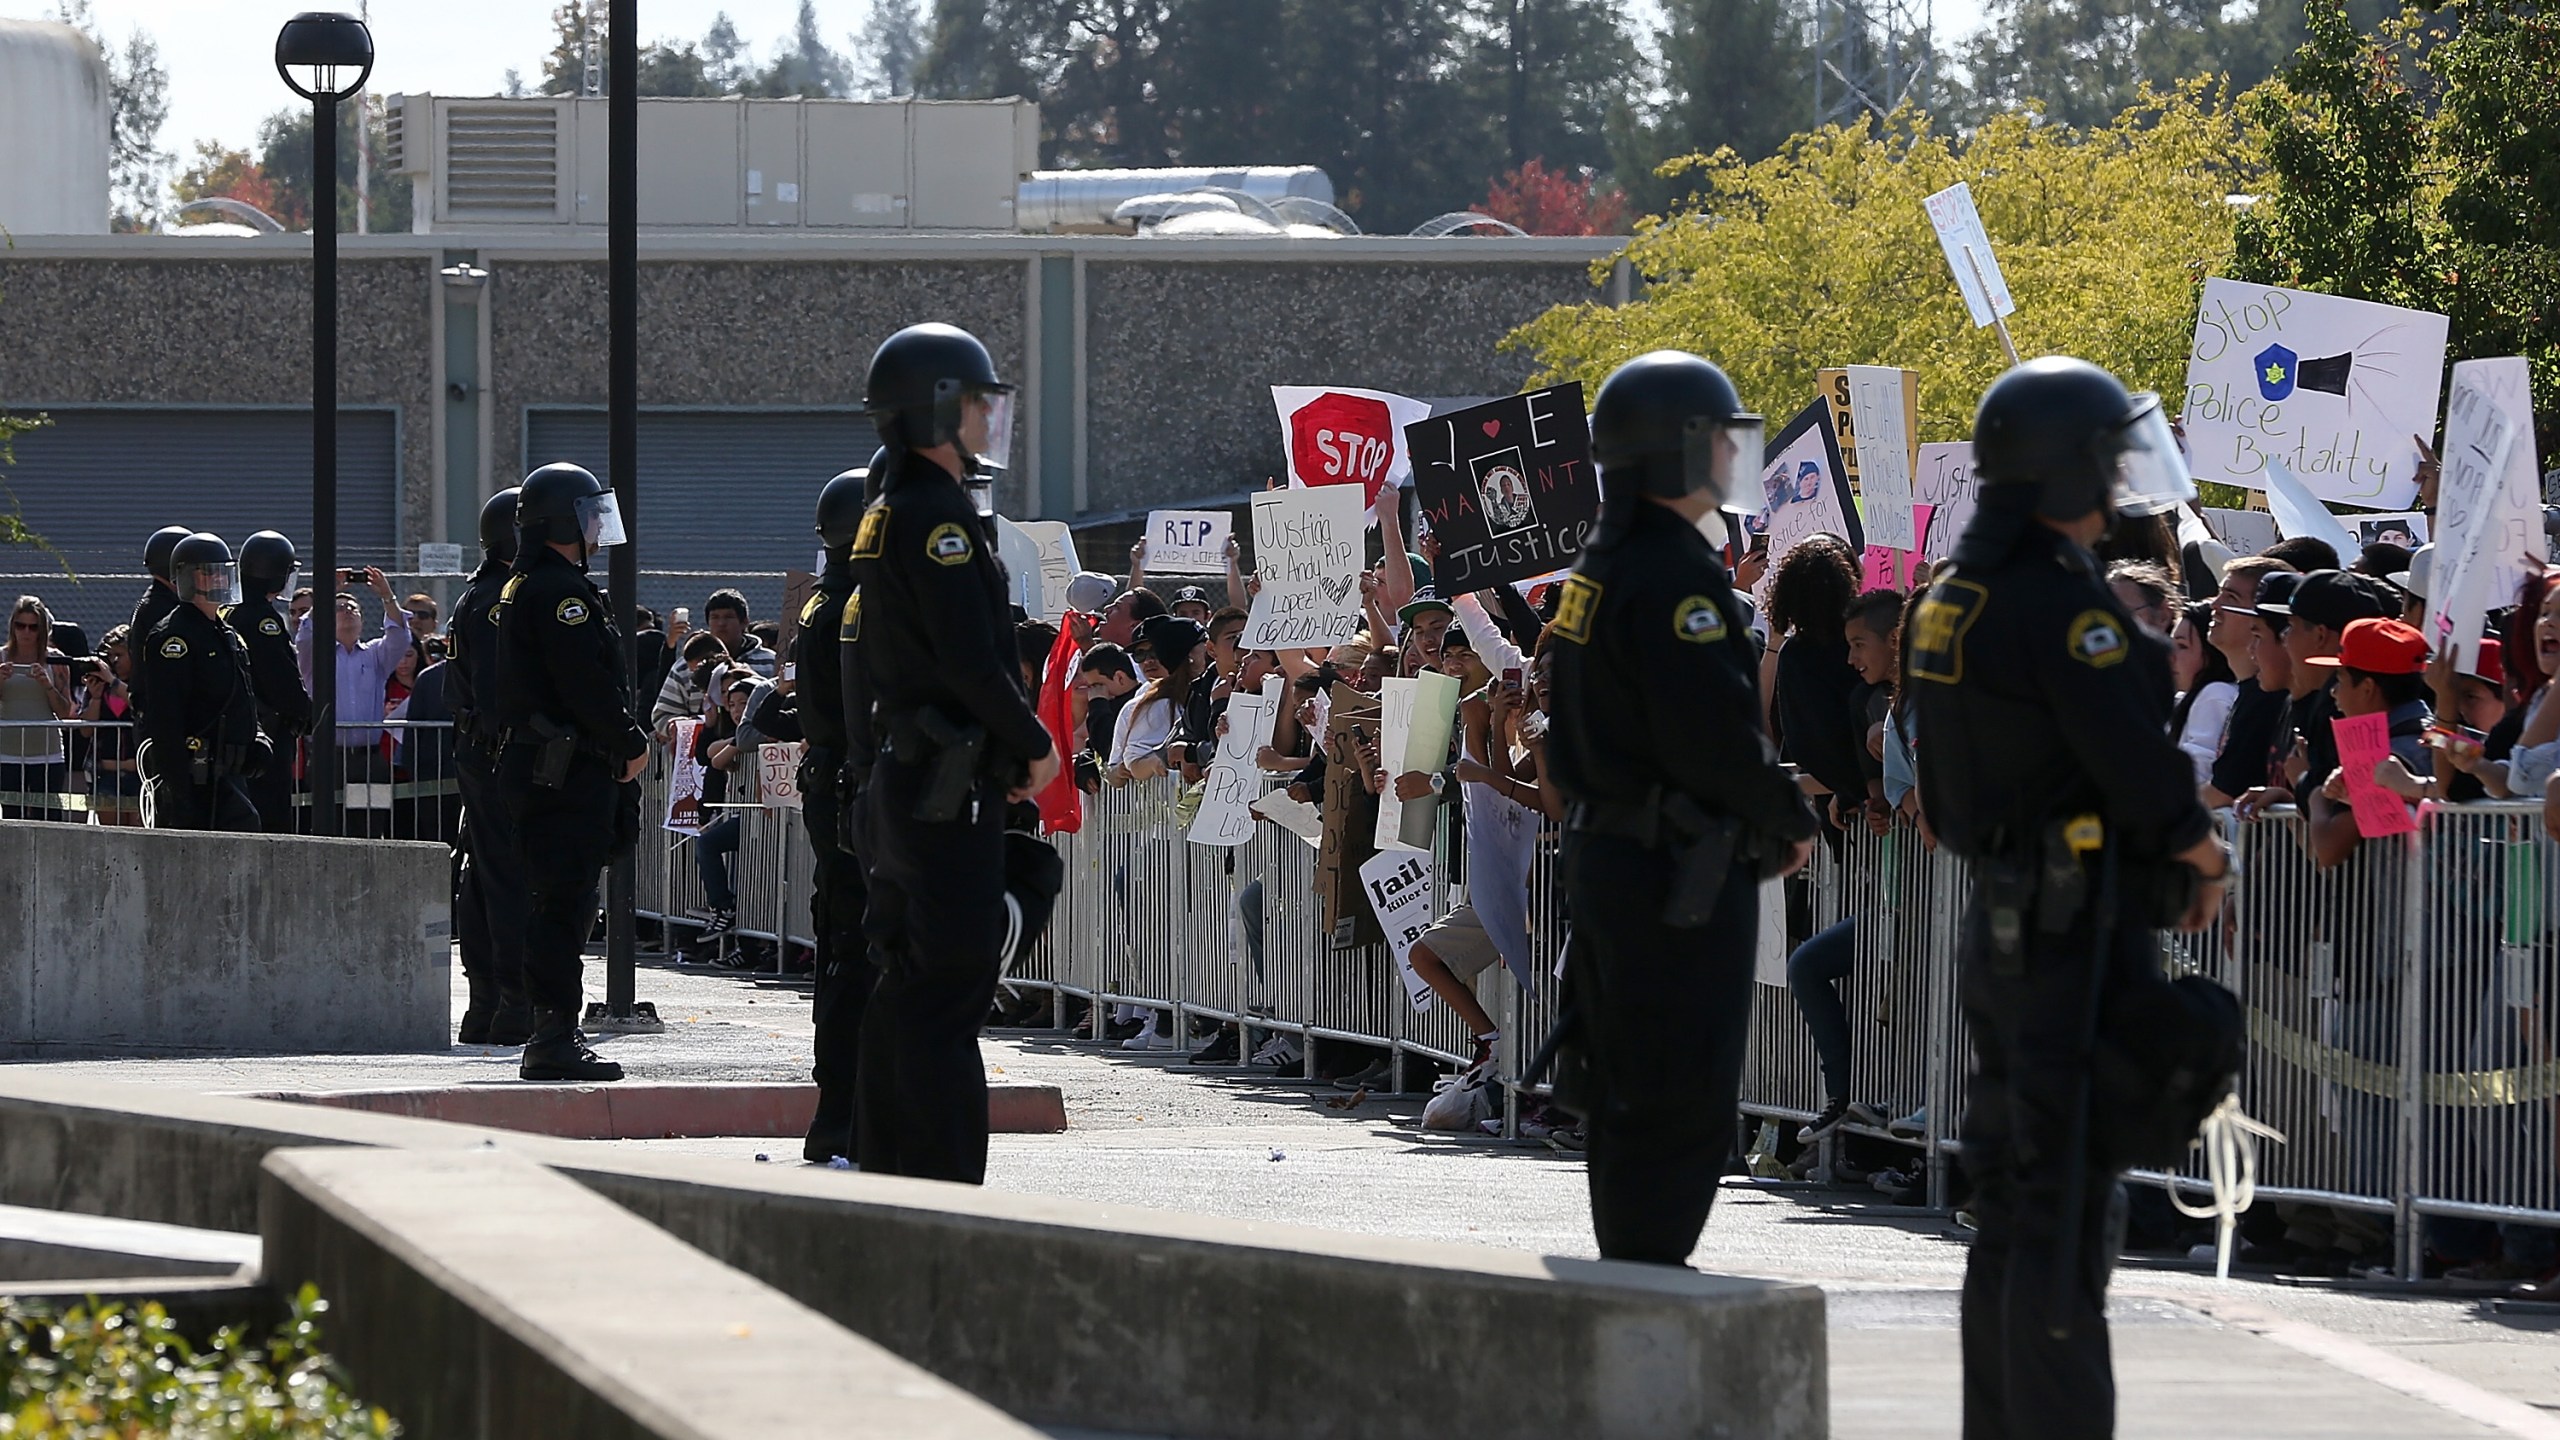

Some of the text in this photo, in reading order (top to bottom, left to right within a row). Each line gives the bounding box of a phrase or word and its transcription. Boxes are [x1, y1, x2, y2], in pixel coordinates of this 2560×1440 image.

[2186, 383, 2286, 436] Police
[1317, 429, 1387, 481] STOP
[1154, 550, 1188, 562] ANDY
[1287, 550, 1322, 584] Andy
[1324, 542, 1352, 567] RIP
[1450, 520, 1587, 581] Justice
[1370, 857, 1425, 909] Jail
[1387, 889, 1421, 914] Killer
